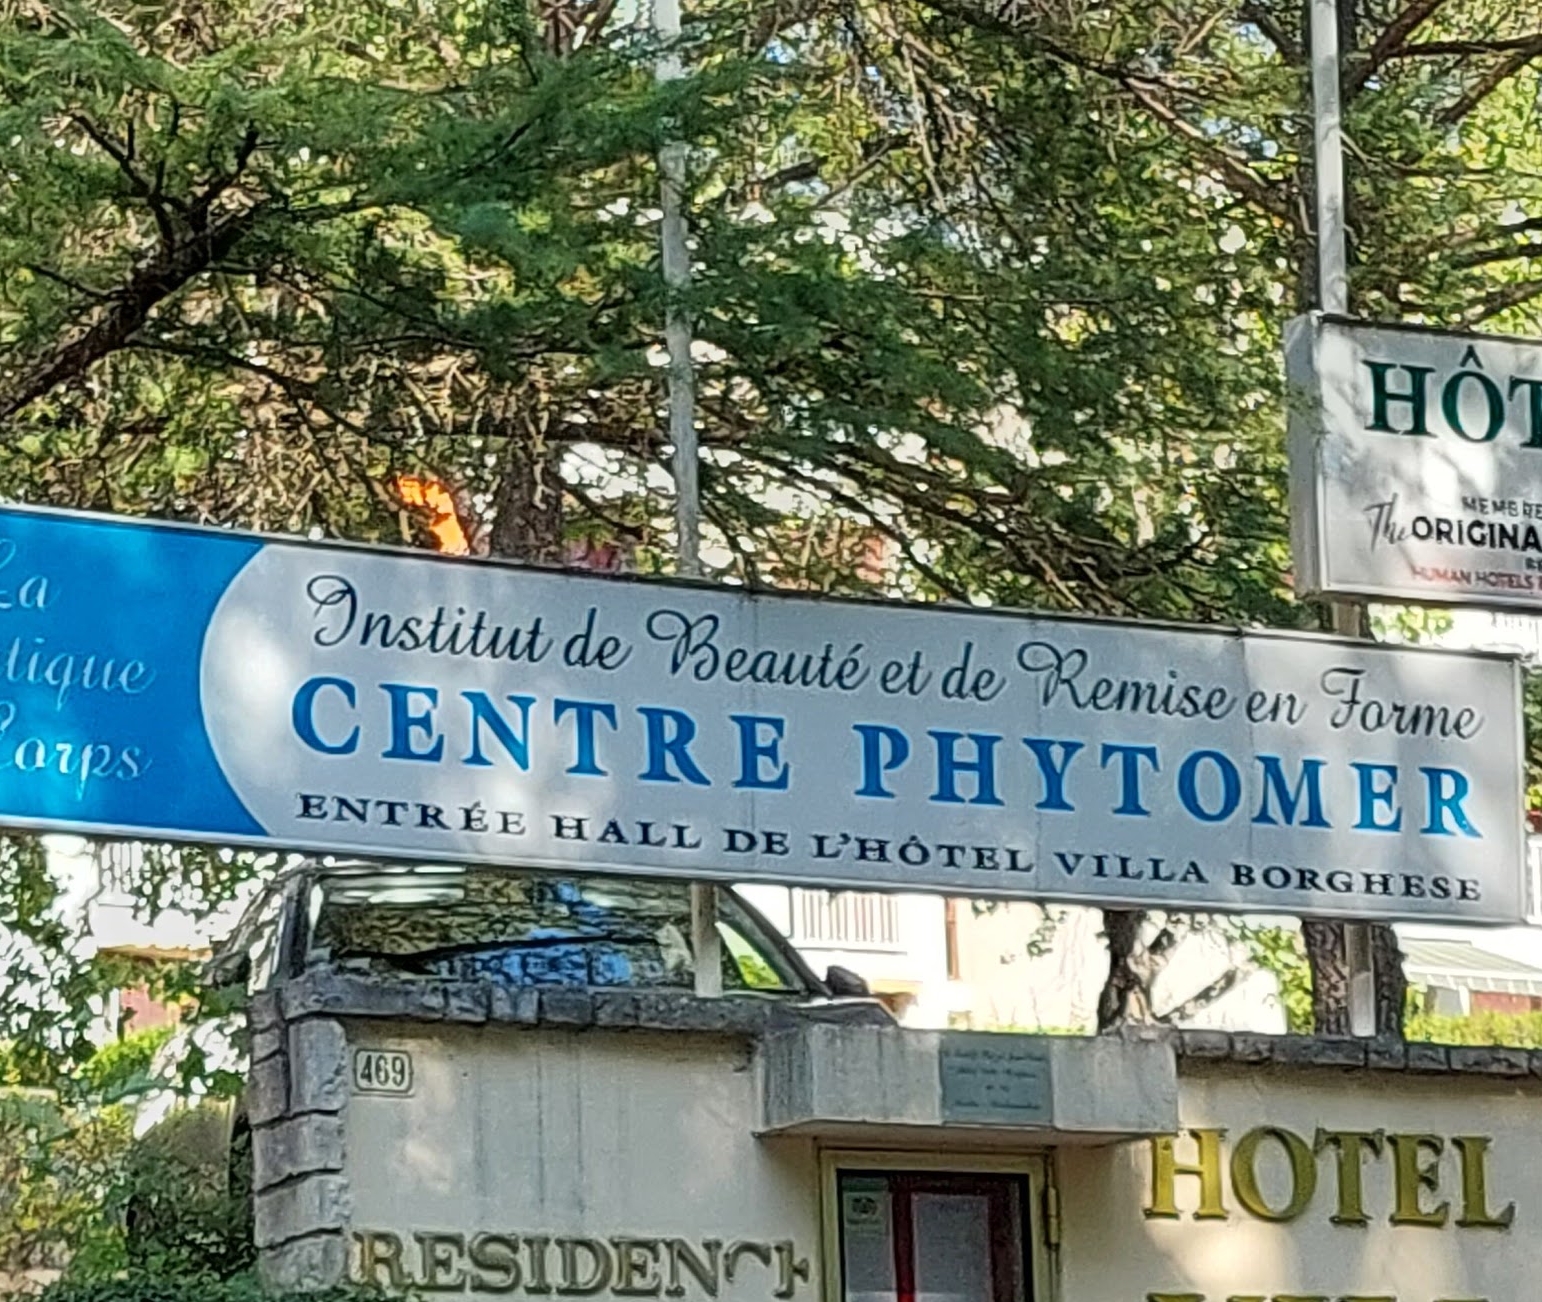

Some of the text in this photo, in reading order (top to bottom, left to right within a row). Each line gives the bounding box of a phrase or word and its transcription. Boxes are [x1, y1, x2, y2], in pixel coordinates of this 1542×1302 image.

[1410, 564, 1472, 585] HUMAN
[1475, 570, 1533, 590] HOTELS
[306, 574, 1484, 741] Institut de Beauté et de Remise en Forme
[291, 674, 1484, 840] CENTRE PHYTOMER
[295, 792, 527, 837] ENTRÉE
[552, 813, 704, 852] HALL
[722, 826, 792, 857] DE
[1055, 850, 1209, 886] VILLA
[1232, 862, 1483, 905] BORGHESE
[360, 1054, 405, 1087] 469
[1143, 1125, 1515, 1230] HOTEL
